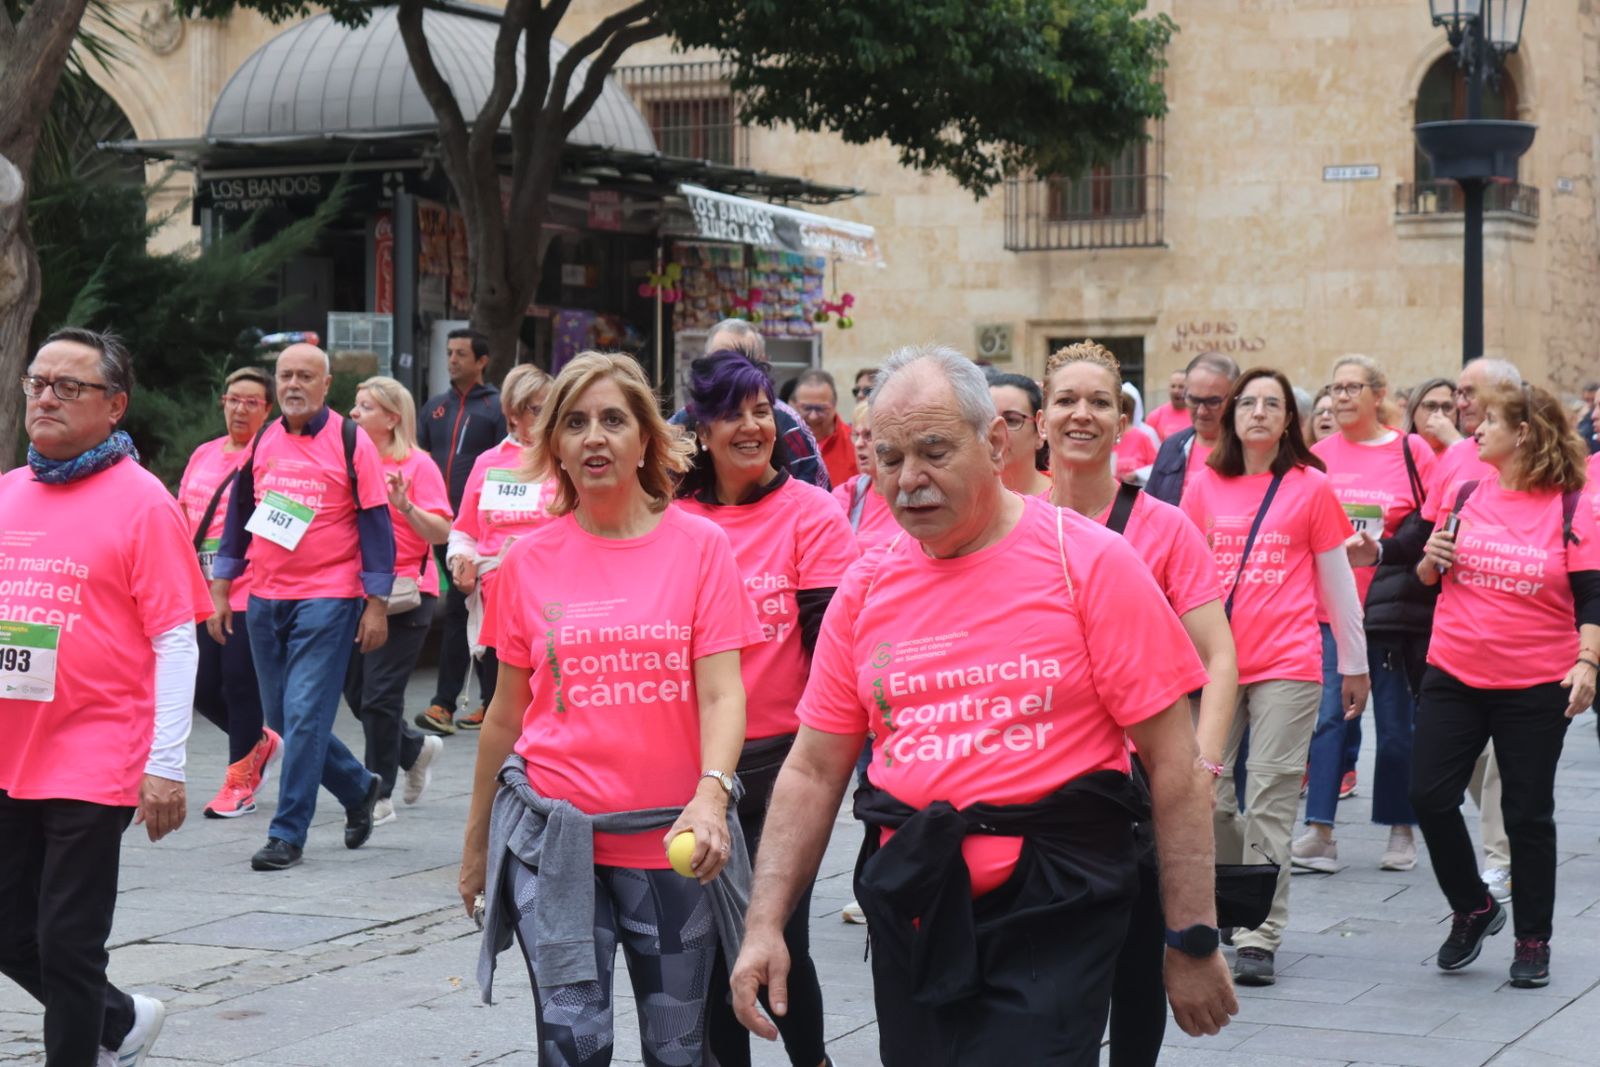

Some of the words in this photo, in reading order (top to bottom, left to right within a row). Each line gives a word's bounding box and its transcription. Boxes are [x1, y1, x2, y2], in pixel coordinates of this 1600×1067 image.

[210, 180, 244, 199] LOS
[248, 176, 321, 196] BANDOS
[278, 476, 327, 492] marcha
[497, 483, 527, 497] 1449
[267, 510, 293, 529] 1451
[1214, 532, 1232, 546] En
[1462, 535, 1482, 550] En
[1485, 540, 1548, 560] marcha
[18, 555, 89, 579] marcha
[1270, 548, 1286, 564] el
[1457, 552, 1522, 574] contra
[1523, 560, 1545, 578] el
[57, 583, 82, 605] el
[1457, 568, 1544, 596] cáncer
[762, 594, 788, 616] el
[560, 625, 592, 646] En
[599, 620, 691, 643] marcha
[562, 647, 661, 676] contra
[664, 646, 689, 671] el
[889, 671, 927, 697] En
[936, 654, 1062, 690] marcha
[567, 675, 691, 708] cáncer
[896, 694, 1013, 727] contra
[1018, 686, 1054, 715] el
[893, 722, 1054, 764] cáncer
